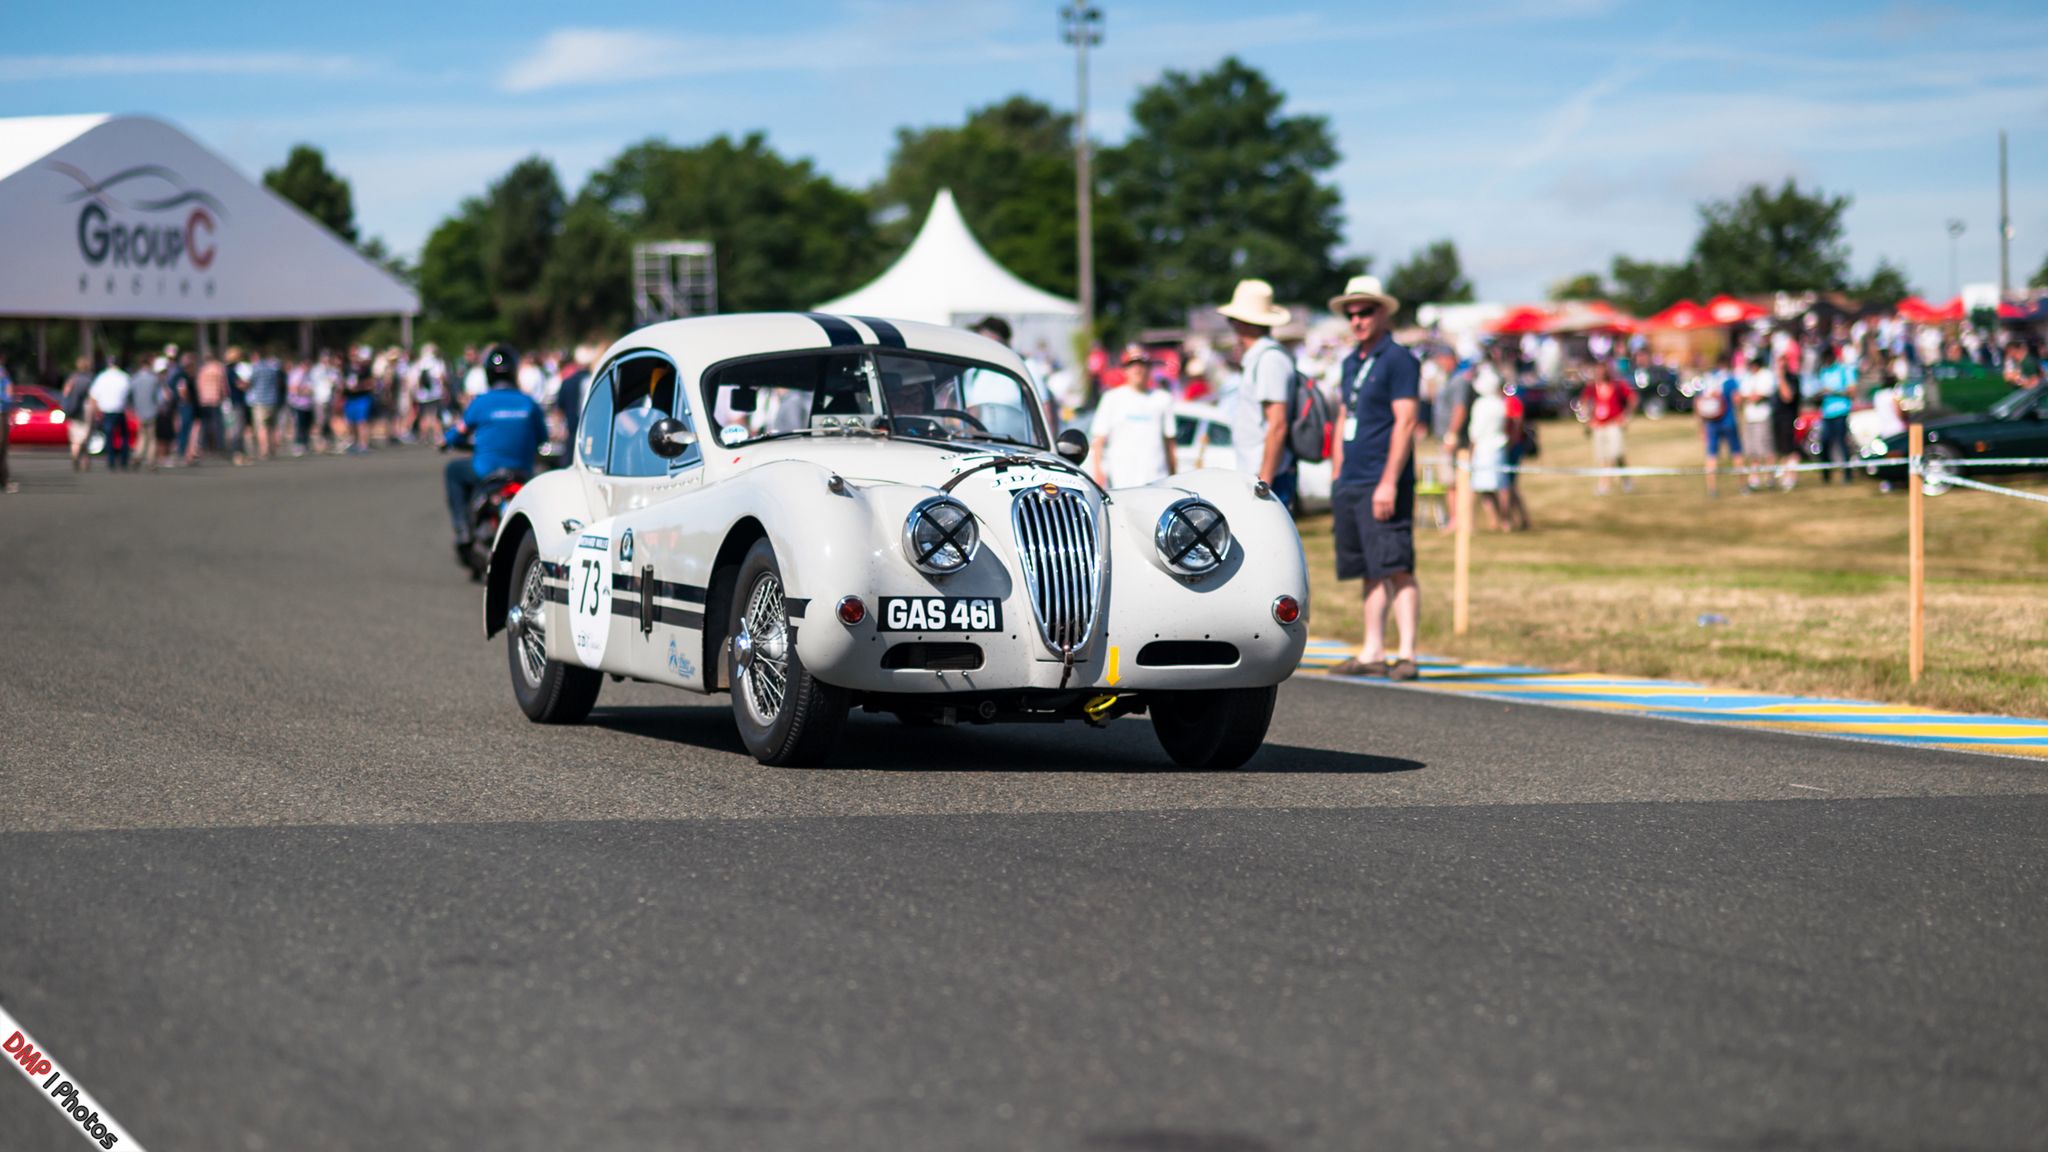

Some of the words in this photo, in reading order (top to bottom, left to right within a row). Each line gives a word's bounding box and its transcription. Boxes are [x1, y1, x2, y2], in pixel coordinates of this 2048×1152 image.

[579, 559, 601, 617] 73
[887, 598, 946, 630] GAS
[950, 598, 997, 630] 461
